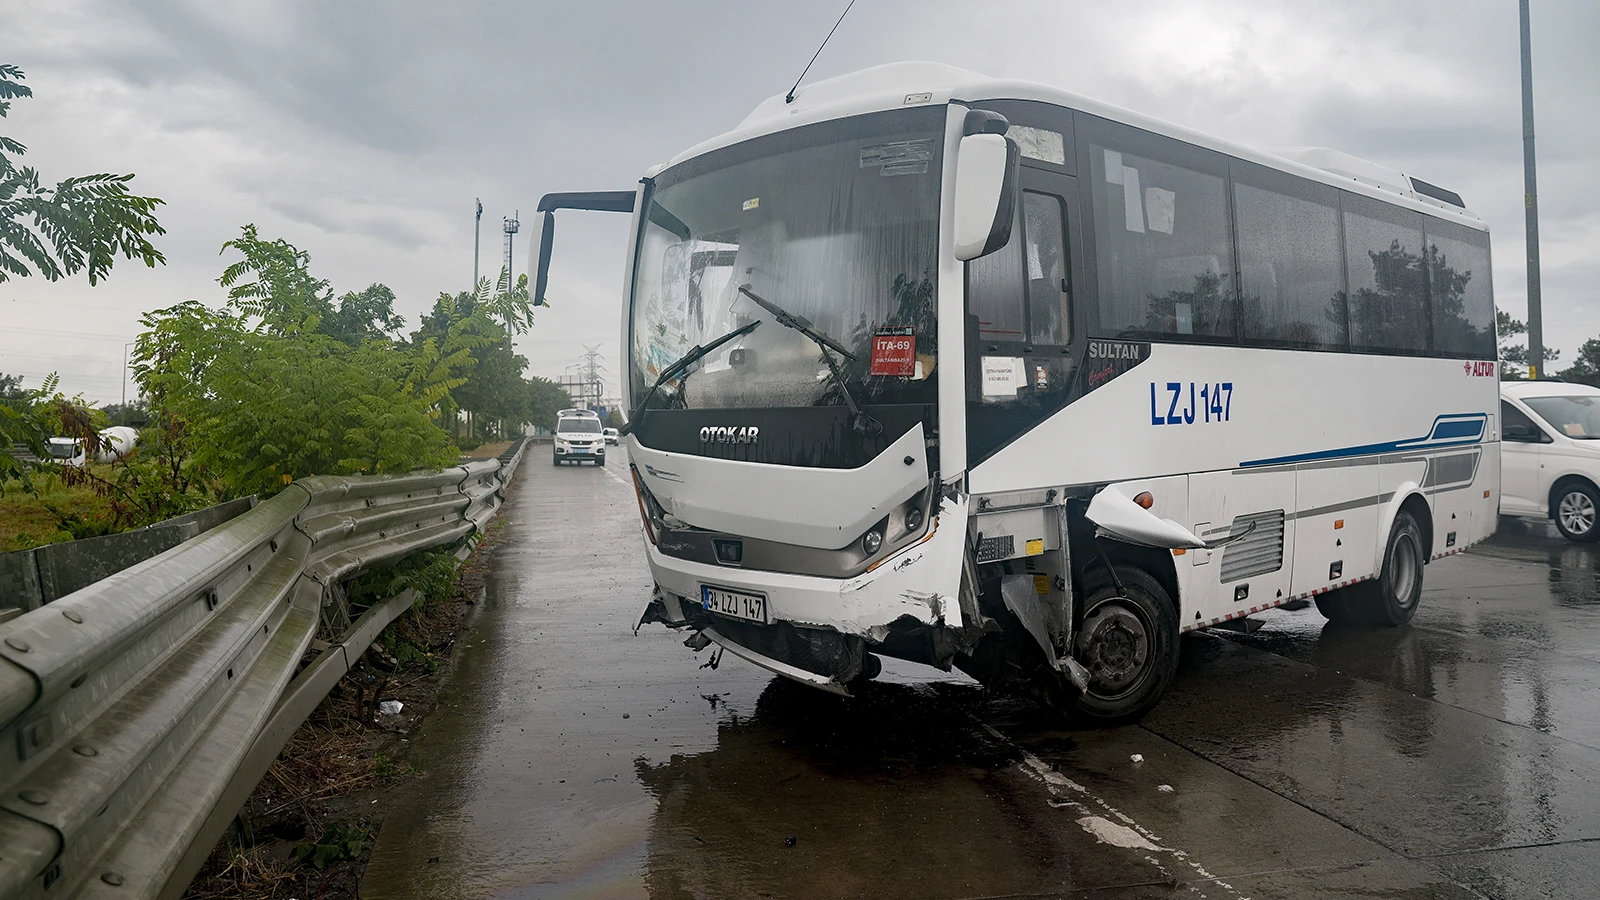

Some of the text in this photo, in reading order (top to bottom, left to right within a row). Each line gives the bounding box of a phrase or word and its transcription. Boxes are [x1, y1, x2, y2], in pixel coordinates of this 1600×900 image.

[877, 340, 910, 350] İTA-69
[1089, 342, 1139, 360] SULTAN
[1472, 361, 1495, 377] ALTUR
[1150, 382, 1233, 425] LZJ 147
[700, 426, 759, 444] OTOKAR
[708, 591, 718, 610] 34
[721, 593, 738, 615] LZJ
[743, 598, 761, 619] 147
